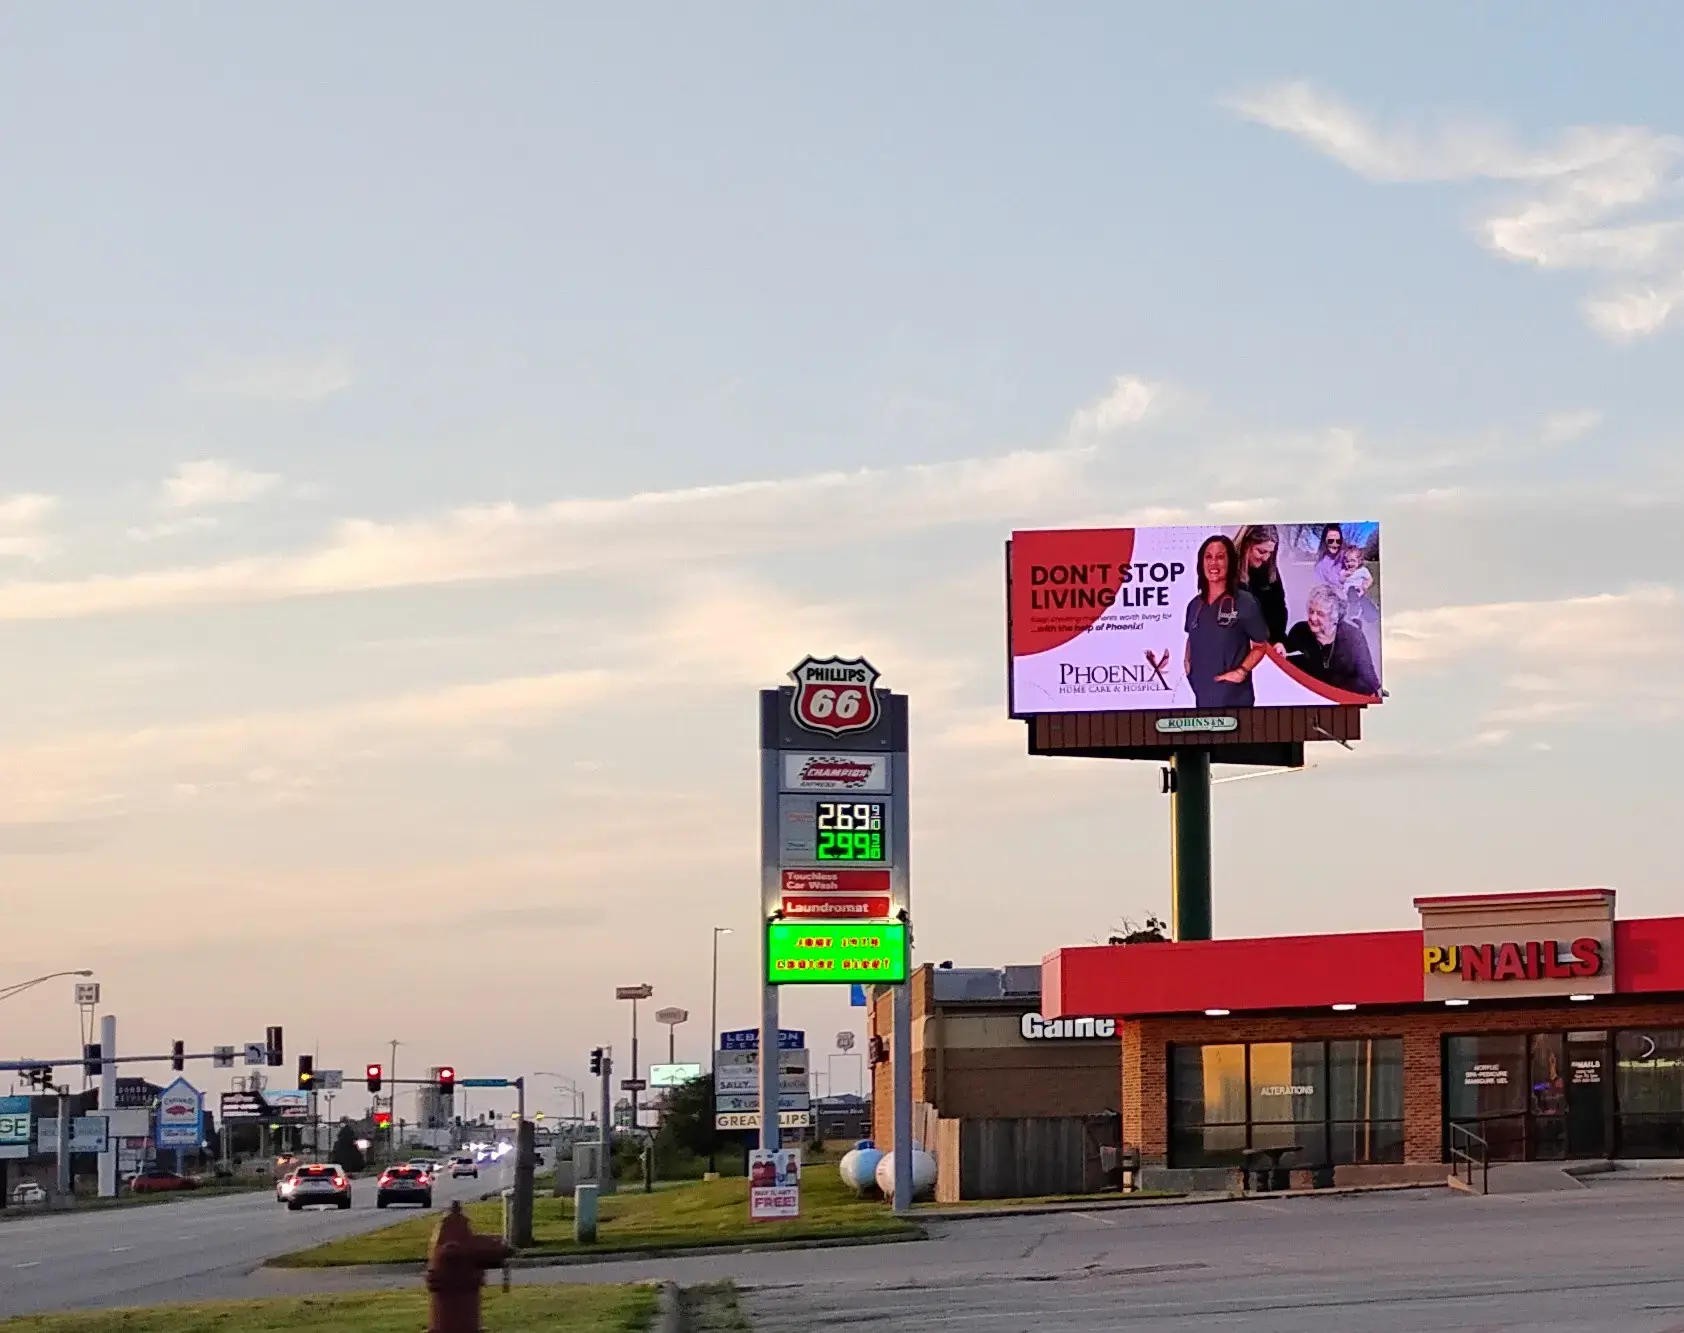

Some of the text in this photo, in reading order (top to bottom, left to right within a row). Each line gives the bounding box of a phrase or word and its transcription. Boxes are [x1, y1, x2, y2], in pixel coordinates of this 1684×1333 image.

[1031, 562, 1185, 586] DON'T STOP
[1031, 586, 1170, 610] LIVING LIFE
[1119, 613, 1140, 621] worth
[1141, 613, 1161, 622] living
[1058, 624, 1073, 632] the
[1075, 623, 1094, 633] help
[1095, 623, 1104, 631] of
[806, 667, 866, 683] PHILLIPS
[1059, 648, 1172, 691] PHOENIX
[1059, 683, 1161, 694] HOME CARE & HOSPICE
[810, 688, 862, 719] 66
[806, 767, 868, 778] CHAMPION
[786, 871, 838, 881] Touchless
[786, 881, 838, 890] Car Wash
[786, 901, 870, 913] Laundromat
[1424, 937, 1602, 982] PJ NAILS
[726, 1032, 799, 1042] LEBON
[720, 1081, 749, 1089] SALLY
[1260, 1085, 1314, 1096] ALTERATIONS
[779, 1114, 807, 1125] LIPS
